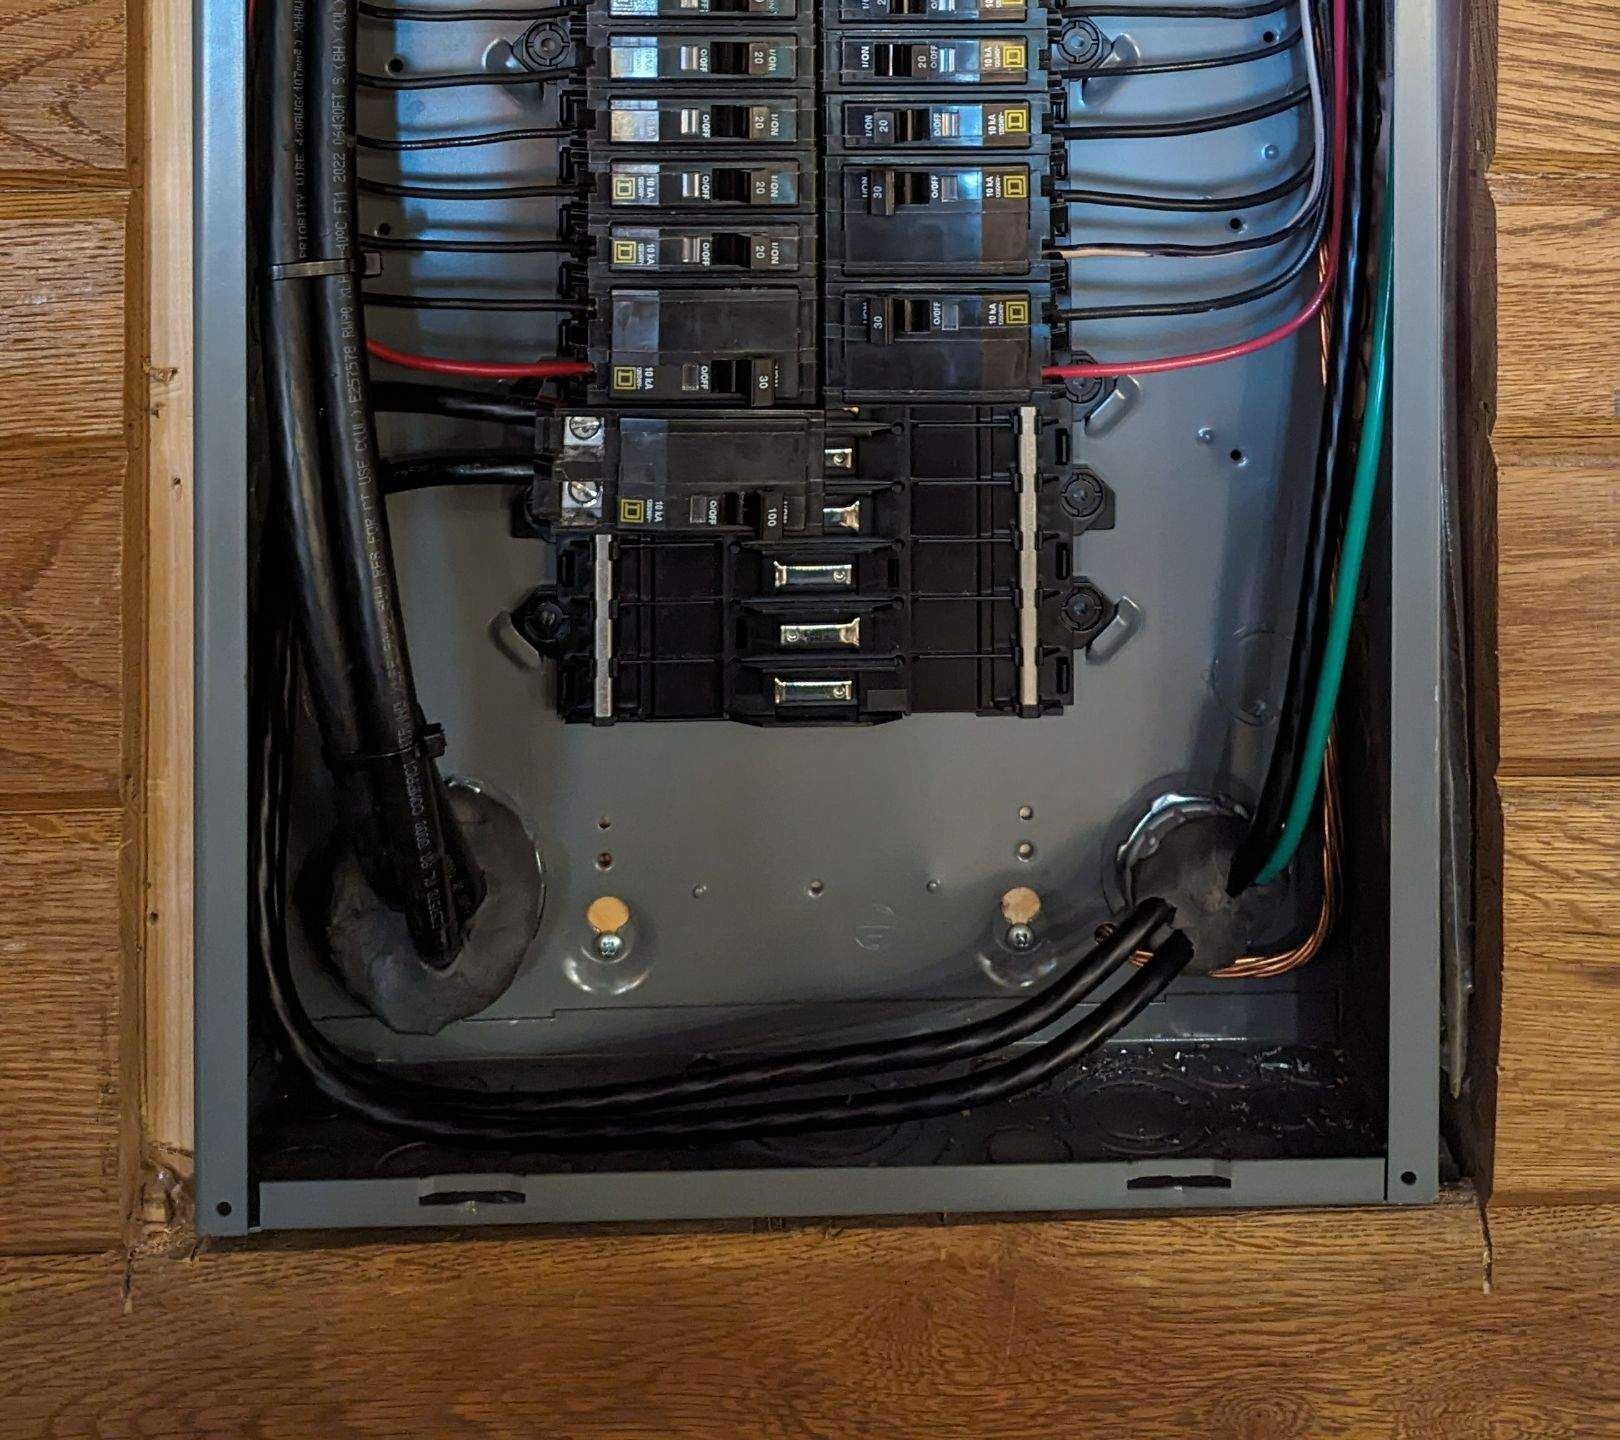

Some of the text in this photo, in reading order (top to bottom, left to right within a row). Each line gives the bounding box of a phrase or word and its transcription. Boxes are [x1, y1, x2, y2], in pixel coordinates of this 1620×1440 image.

[700, 48, 708, 72] O/OFF
[754, 51, 764, 64] 20
[768, 49, 777, 71] I/ON
[862, 46, 870, 68] I/ON
[918, 55, 927, 68] 20
[930, 45, 938, 68] O/OFF
[984, 46, 992, 68] 10 kA
[331, 76, 345, 85] S
[330, 91, 347, 145] 06430FT
[702, 114, 710, 138] O/OFF
[754, 116, 764, 129] 20
[770, 113, 779, 136] I/ON
[864, 116, 873, 137] I/ON
[879, 120, 888, 132] 20
[933, 114, 942, 136] O/OFF
[988, 114, 996, 135] 10 kA
[332, 151, 347, 183] 2022
[646, 175, 656, 198] 10 kA
[702, 175, 710, 200] O/OFF
[756, 181, 766, 194] 20
[770, 175, 779, 198] I/ON
[872, 186, 882, 199] 30
[986, 176, 994, 198] 10 kA
[332, 190, 347, 214] FT1
[646, 243, 656, 265] 10 kA
[702, 242, 710, 266] O/OFF
[756, 246, 766, 259] 20
[771, 242, 779, 264] I/ON
[874, 316, 883, 329] 30
[933, 301, 942, 326] O/OFF
[988, 302, 997, 324] 10 kA
[342, 344, 363, 403] E257578
[645, 366, 654, 390] 10 kA
[700, 365, 709, 390] O/OFF
[758, 375, 769, 389] 30
[654, 500, 664, 522] 10 kA
[709, 500, 718, 525] O/OFF
[768, 508, 777, 527] 100
